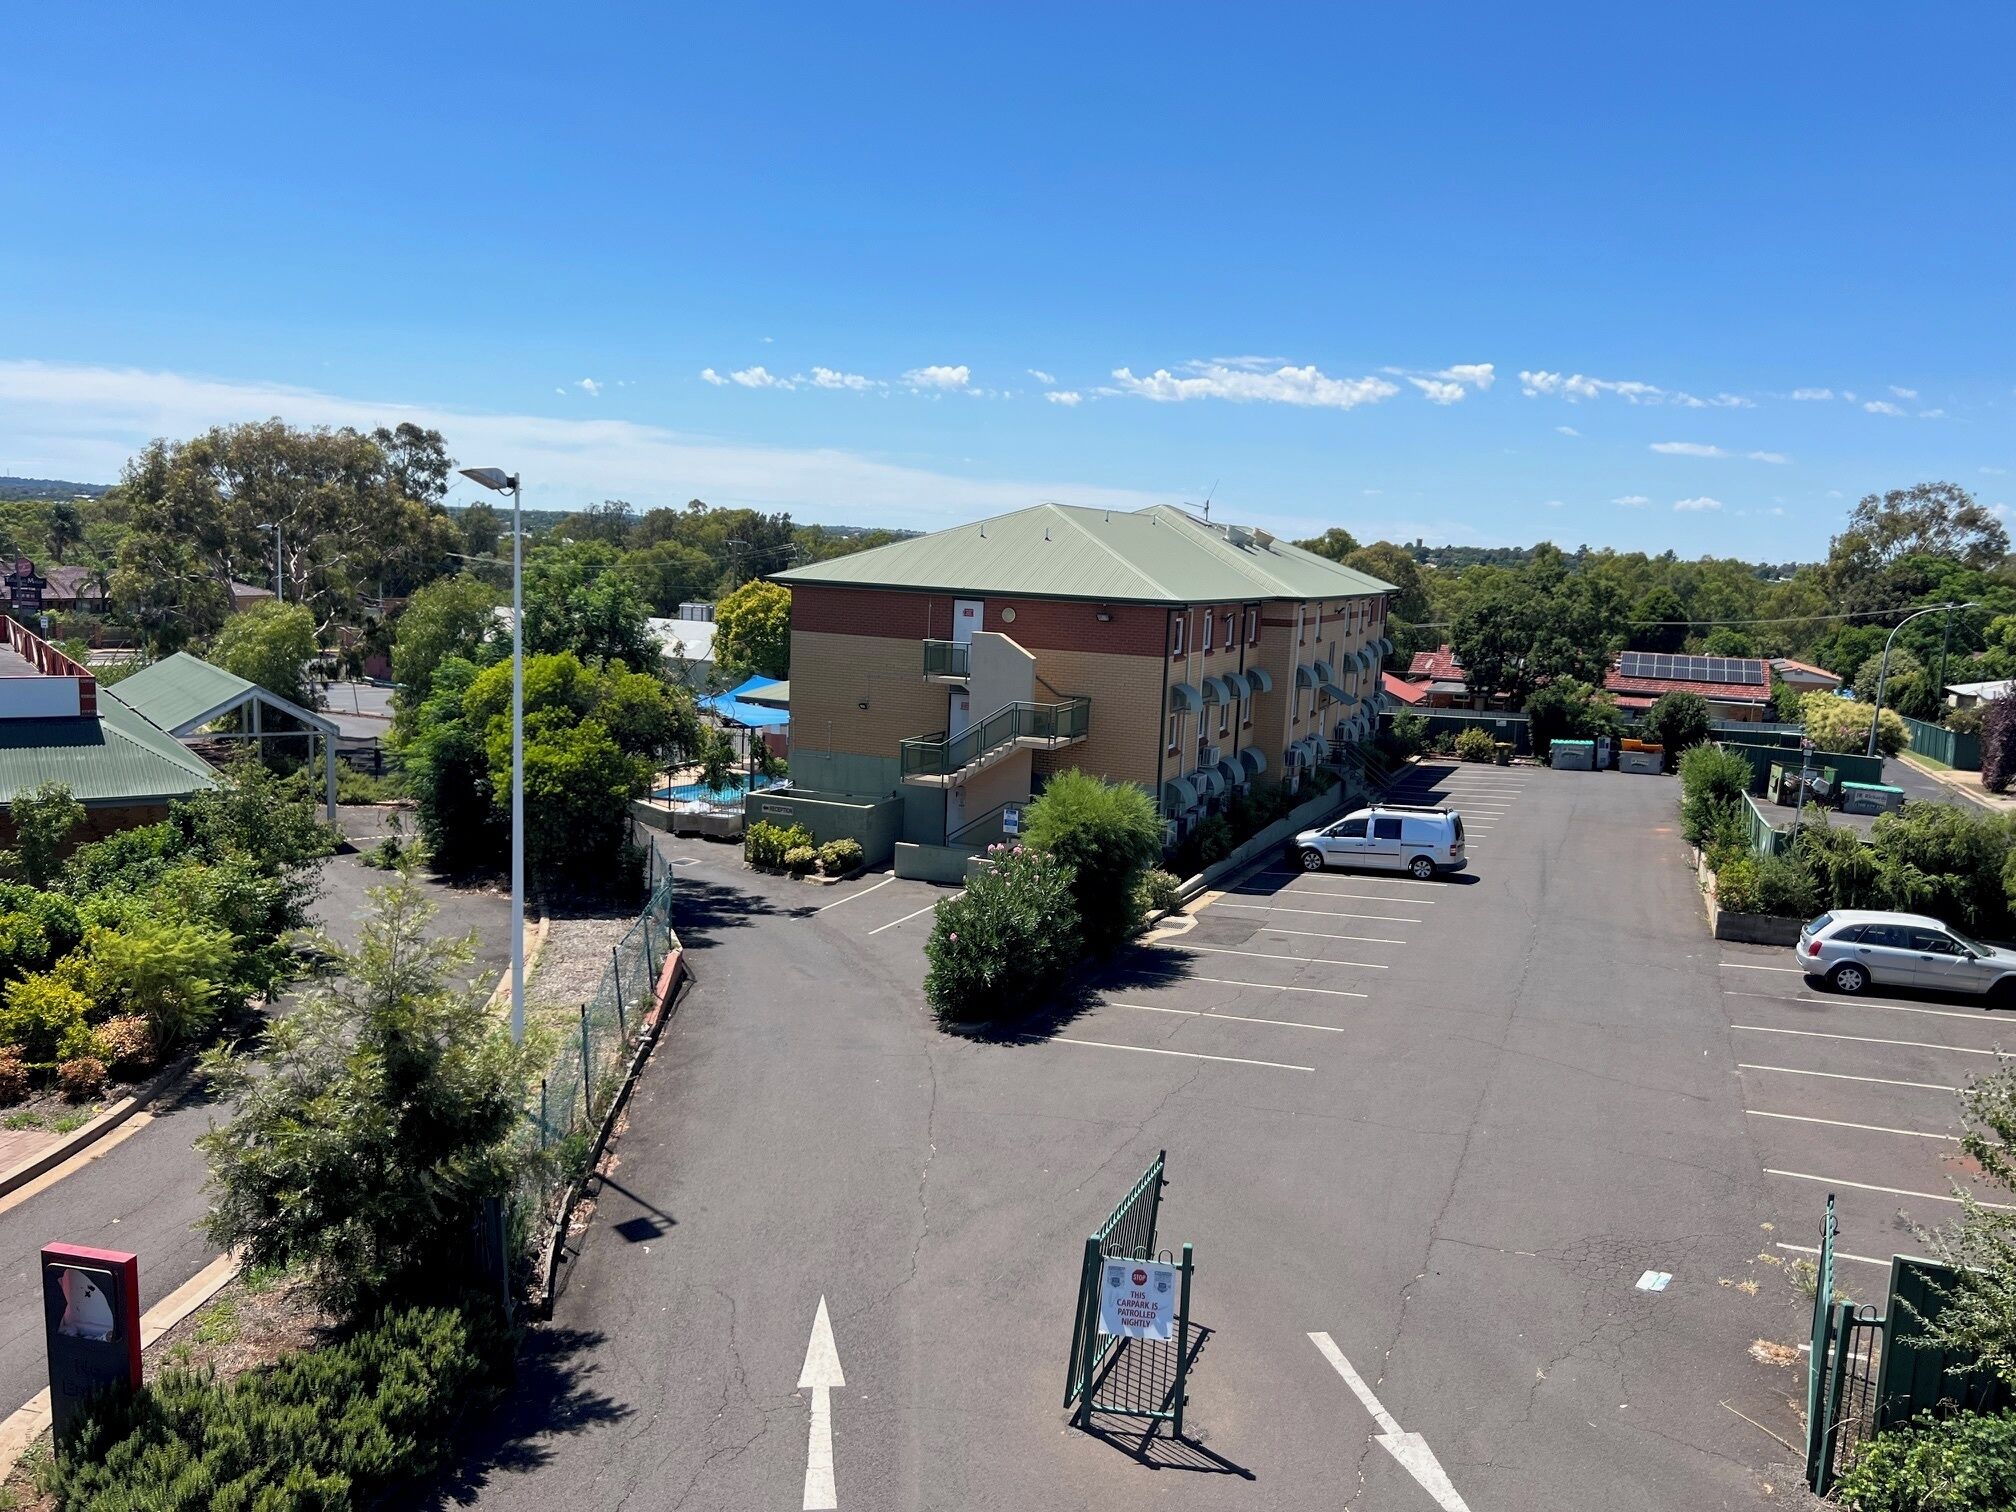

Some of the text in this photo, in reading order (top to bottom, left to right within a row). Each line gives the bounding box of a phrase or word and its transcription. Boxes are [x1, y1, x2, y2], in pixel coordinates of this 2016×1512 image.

[770, 806, 792, 814] RECEPTION
[1132, 1273, 1147, 1281] STOP
[1131, 1291, 1145, 1299] THIS
[1117, 1299, 1150, 1309] CARPARK
[1117, 1308, 1156, 1319] PATROLLED
[1121, 1318, 1151, 1328] NIGHTLY
